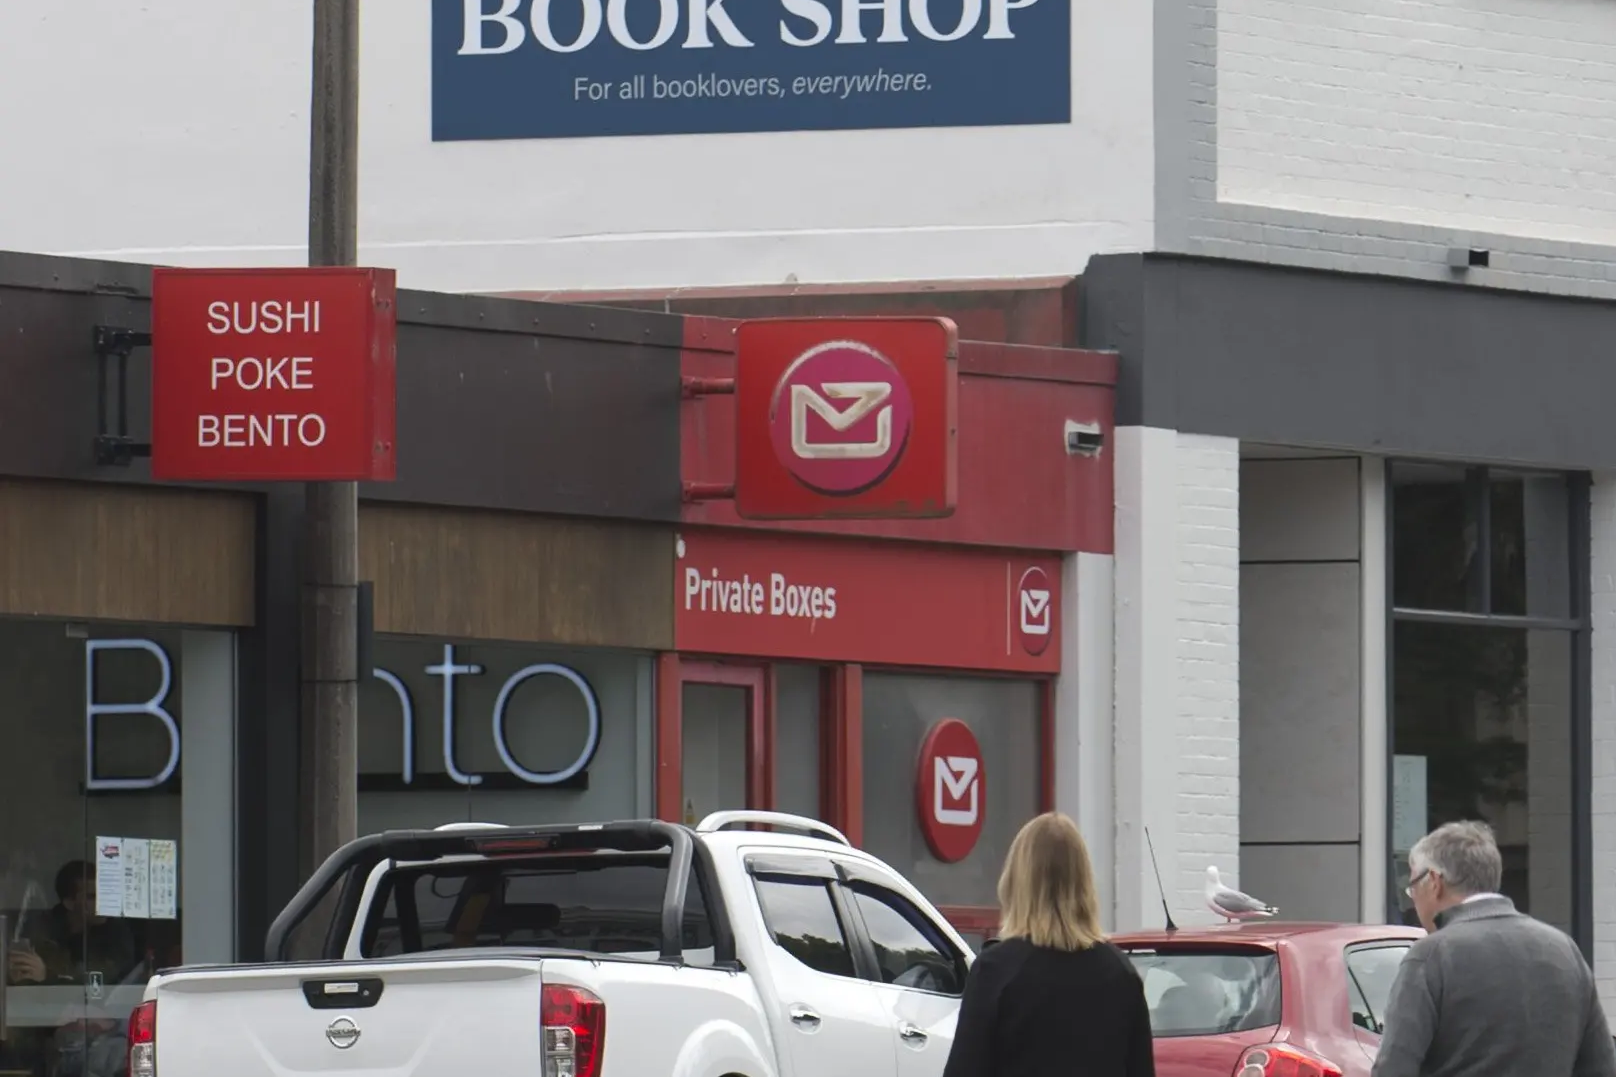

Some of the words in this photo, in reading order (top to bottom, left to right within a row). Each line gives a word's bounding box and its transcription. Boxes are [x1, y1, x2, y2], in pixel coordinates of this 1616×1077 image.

[575, 77, 611, 101] For
[619, 74, 645, 100] all
[653, 73, 786, 99] booklovers,
[792, 68, 932, 100] everywhere.
[207, 300, 320, 334] SUSHI
[211, 357, 314, 390] POKE
[198, 414, 326, 447] BENTO
[685, 568, 764, 615] Private
[770, 573, 837, 619] Boxes
